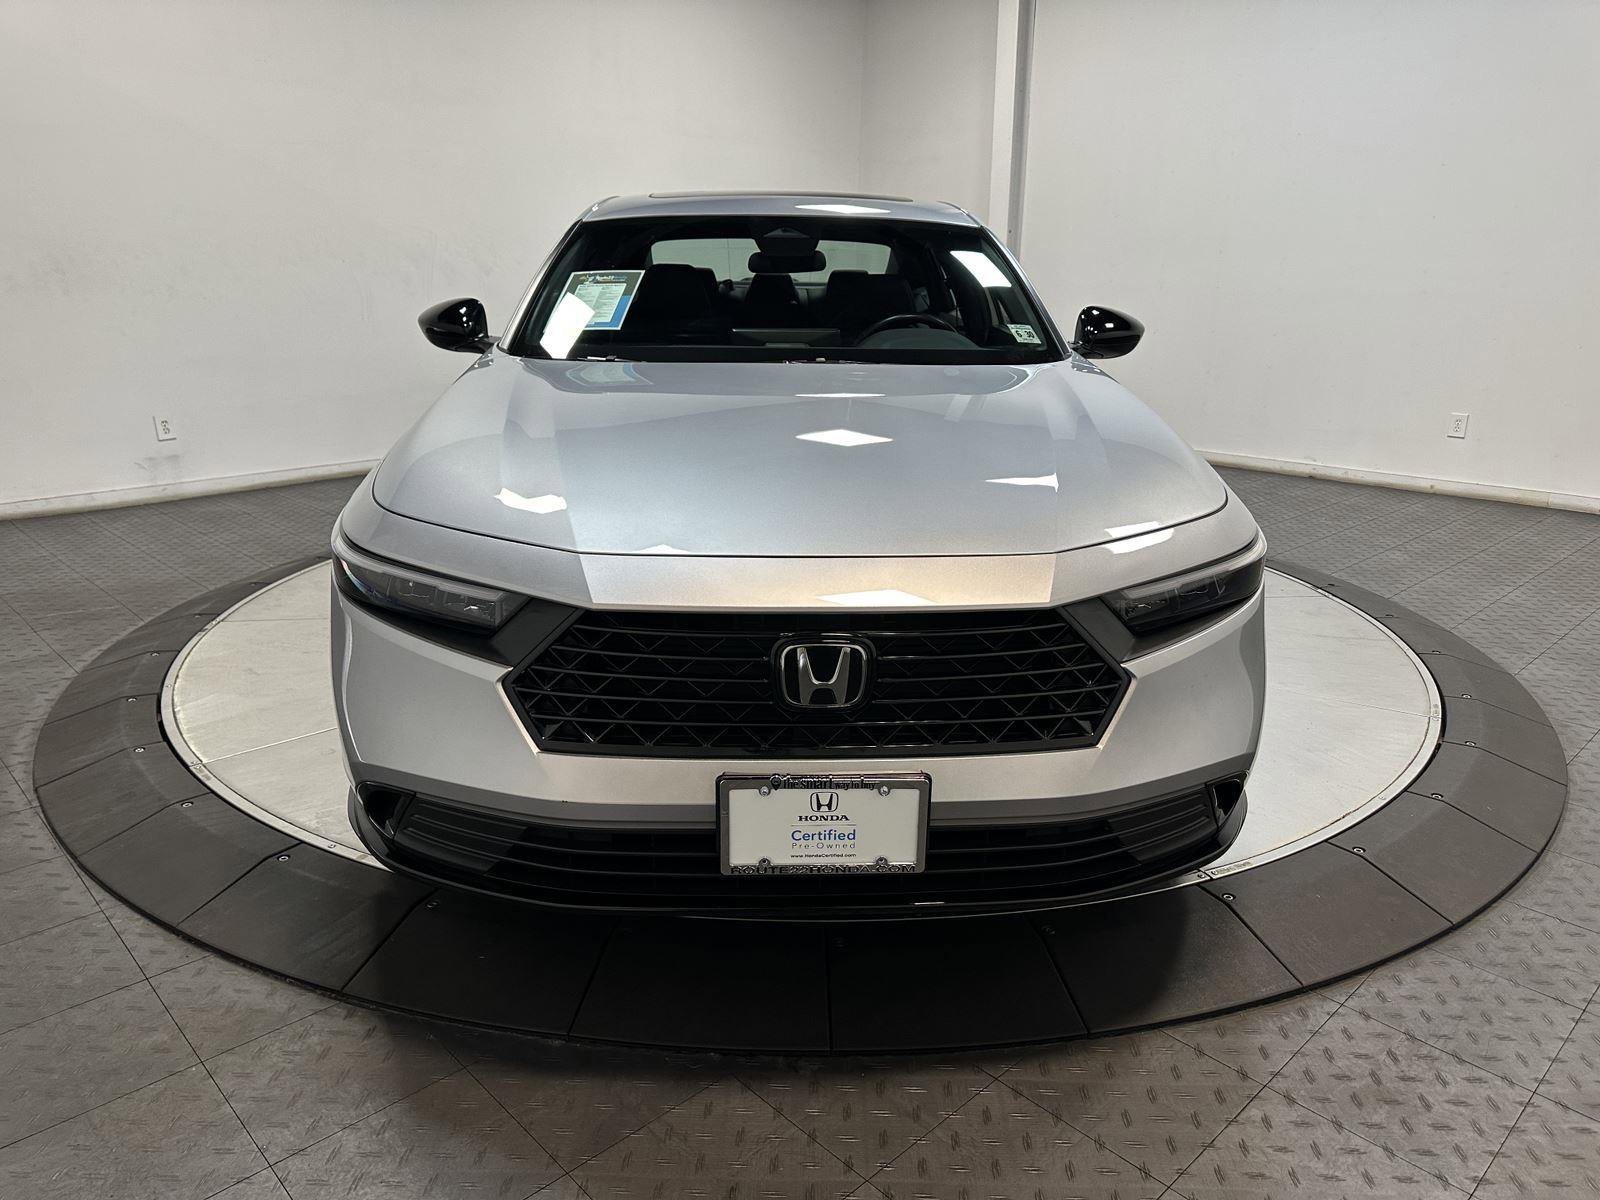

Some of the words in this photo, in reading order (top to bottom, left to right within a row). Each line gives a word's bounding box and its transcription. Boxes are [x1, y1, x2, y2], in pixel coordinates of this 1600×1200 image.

[800, 776, 833, 789] smart
[833, 780, 850, 790] way
[860, 777, 876, 790] buy
[791, 829, 856, 841] Certified
